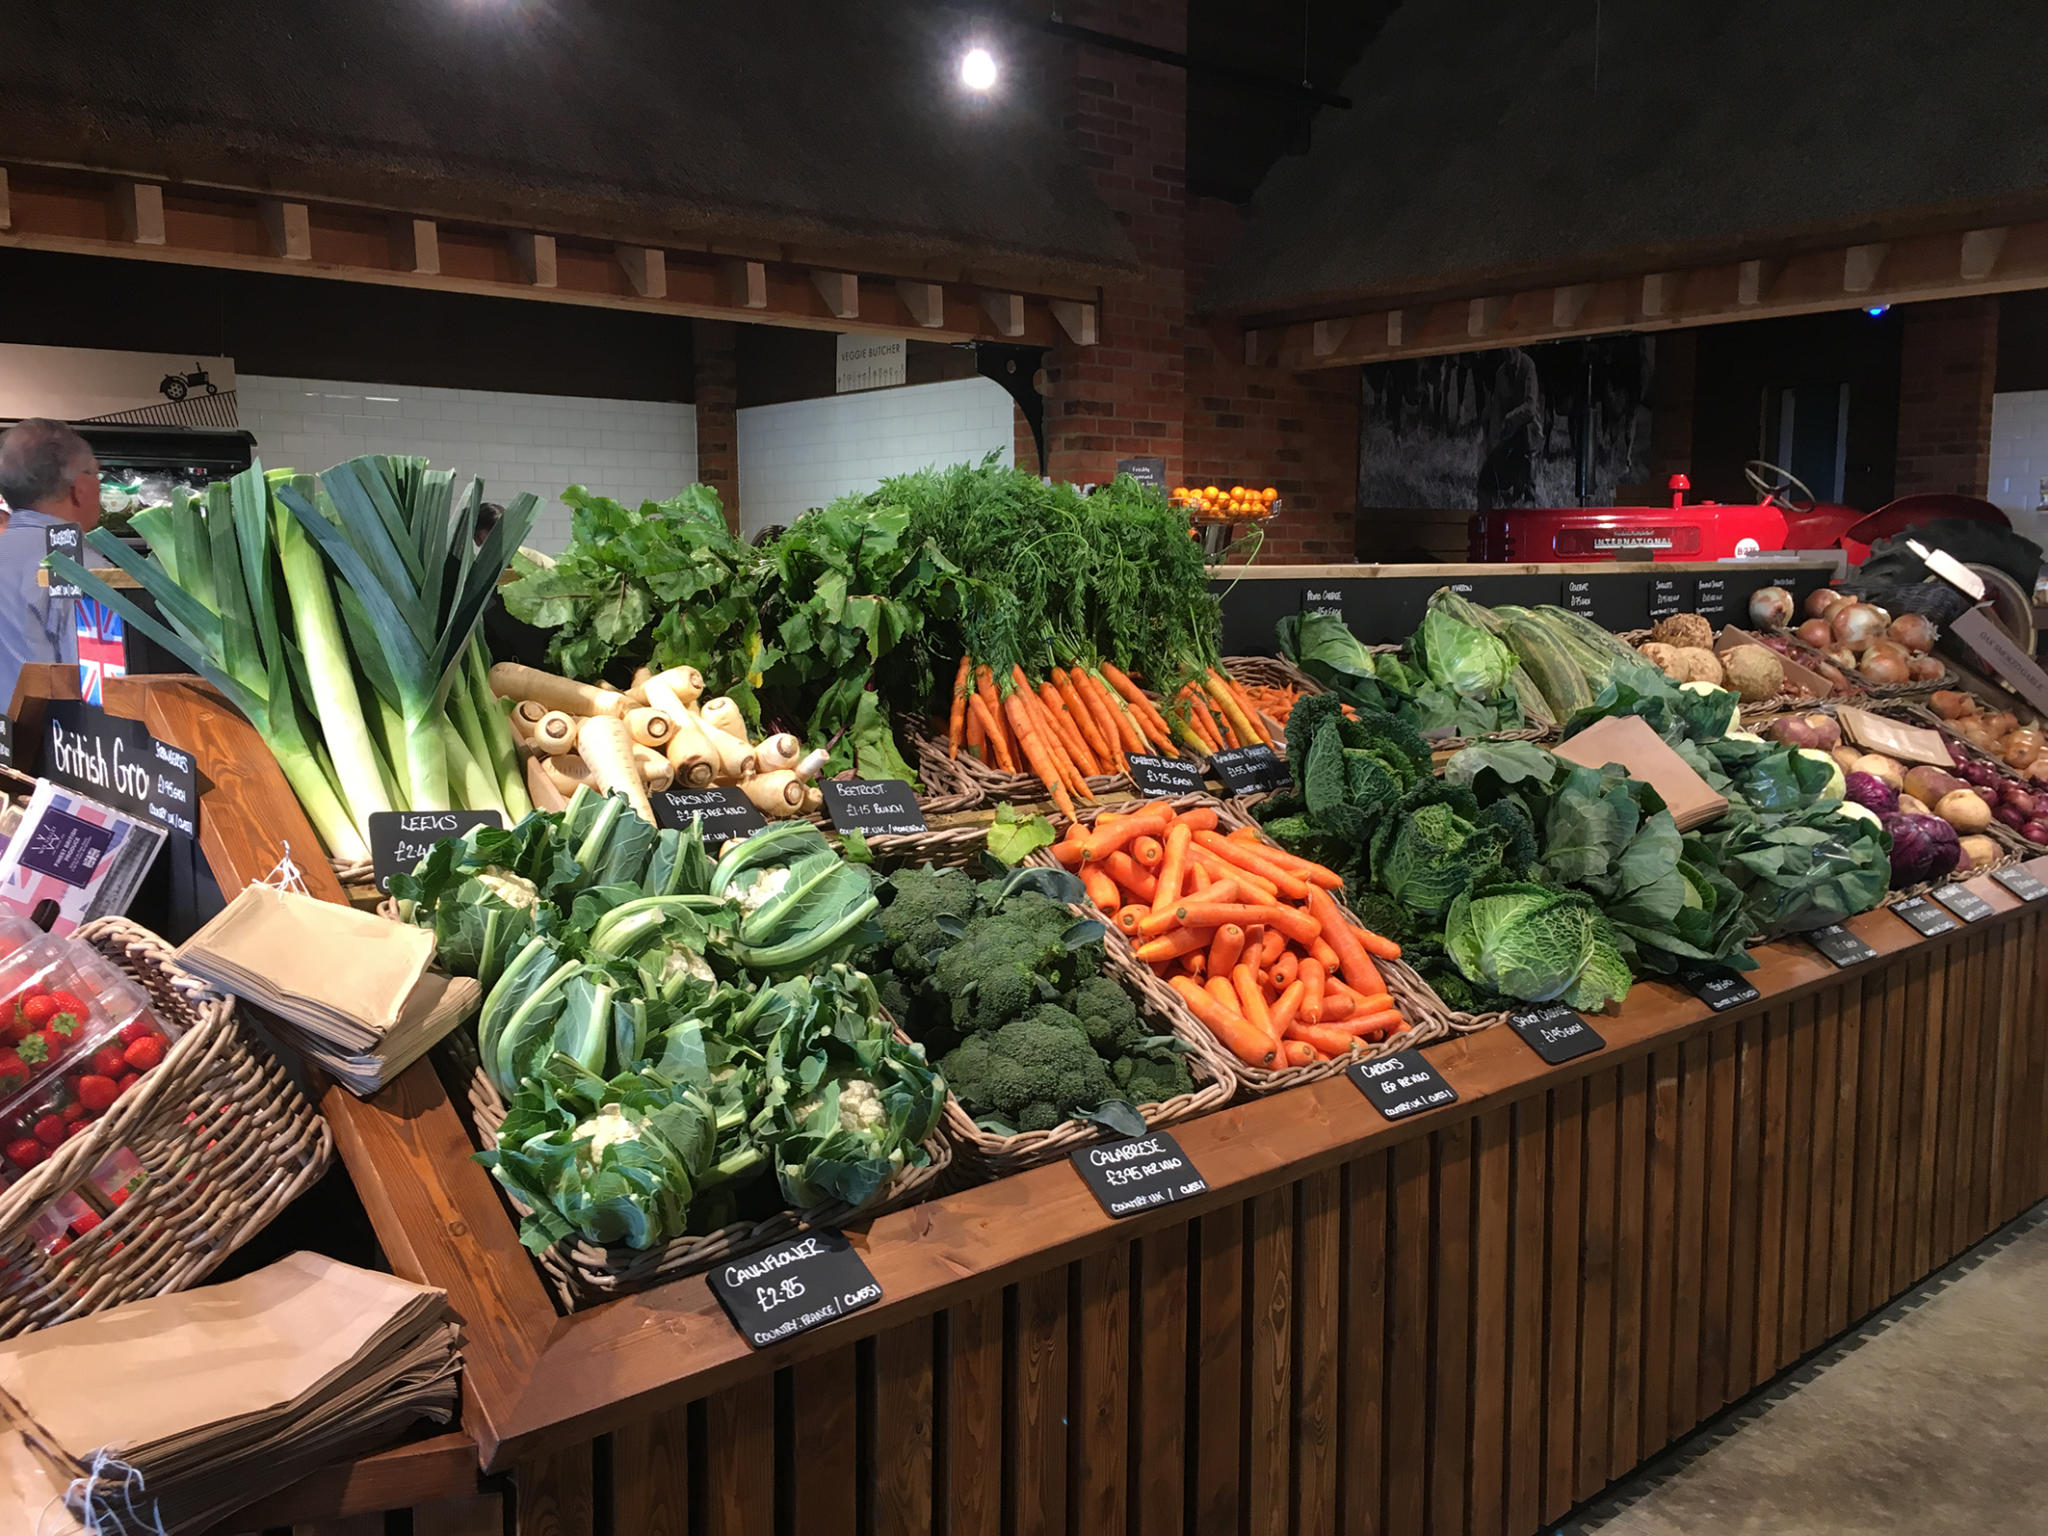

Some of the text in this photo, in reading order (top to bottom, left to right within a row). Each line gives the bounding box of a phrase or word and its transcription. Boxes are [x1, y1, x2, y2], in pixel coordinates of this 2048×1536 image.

[841, 344, 901, 361] VEGGIE BUTCHER
[1594, 538, 1672, 547] INTERNATIONAL
[53, 719, 149, 800] British Gro
[665, 791, 726, 806] PARSNIPS
[873, 803, 904, 814] BUNCH
[400, 814, 458, 832] LEEKS
[63, 835, 80, 862] PRODUCE
[394, 840, 426, 862] £2.4
[1564, 1017, 1584, 1036] EACH
[1360, 1057, 1405, 1079] CARROTS
[1396, 1075, 1414, 1089] PER
[1410, 1071, 1430, 1084] KILO
[1090, 1138, 1167, 1167] CALABRESE
[1142, 1162, 1162, 1176] PER
[1158, 1157, 1183, 1171] KILO
[724, 1237, 825, 1288] CAULIFLOWER
[801, 1304, 837, 1326] FRANCE
